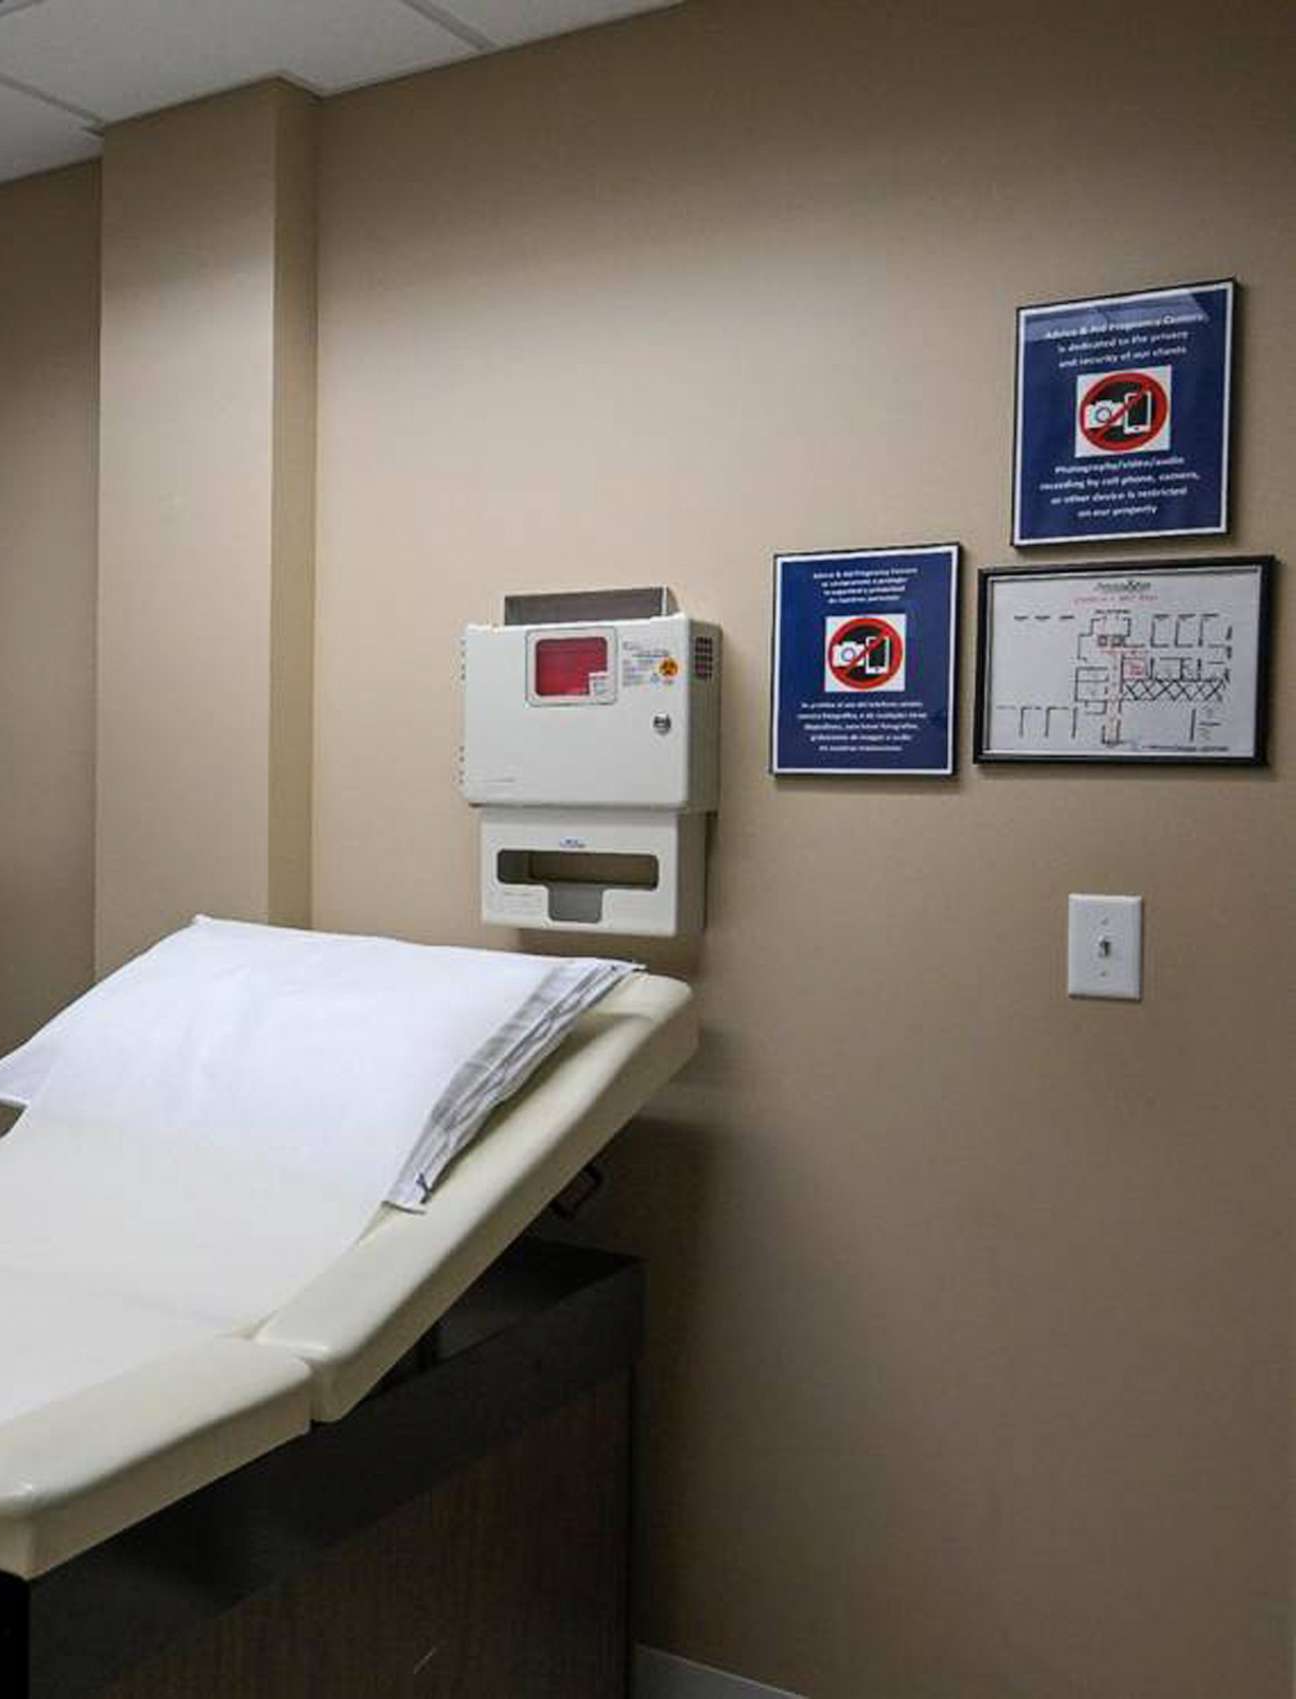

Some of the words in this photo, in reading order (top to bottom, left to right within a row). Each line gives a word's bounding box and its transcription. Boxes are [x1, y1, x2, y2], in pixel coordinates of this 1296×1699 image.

[1079, 326, 1088, 335] &
[1068, 338, 1116, 352] dedicated
[1118, 337, 1129, 346] to
[1132, 333, 1148, 343] the
[1150, 331, 1189, 343] privacy
[1059, 359, 1078, 368] and
[1079, 353, 1118, 366] security
[1120, 351, 1131, 361] of
[1133, 350, 1150, 359] our
[1086, 478, 1099, 488] by
[1102, 476, 1120, 485] cell
[1050, 497, 1061, 505] or
[1063, 494, 1090, 504] other
[1092, 492, 1125, 501] device
[1077, 509, 1091, 518] on
[1093, 508, 1111, 517] our
[1112, 504, 1158, 517] property
